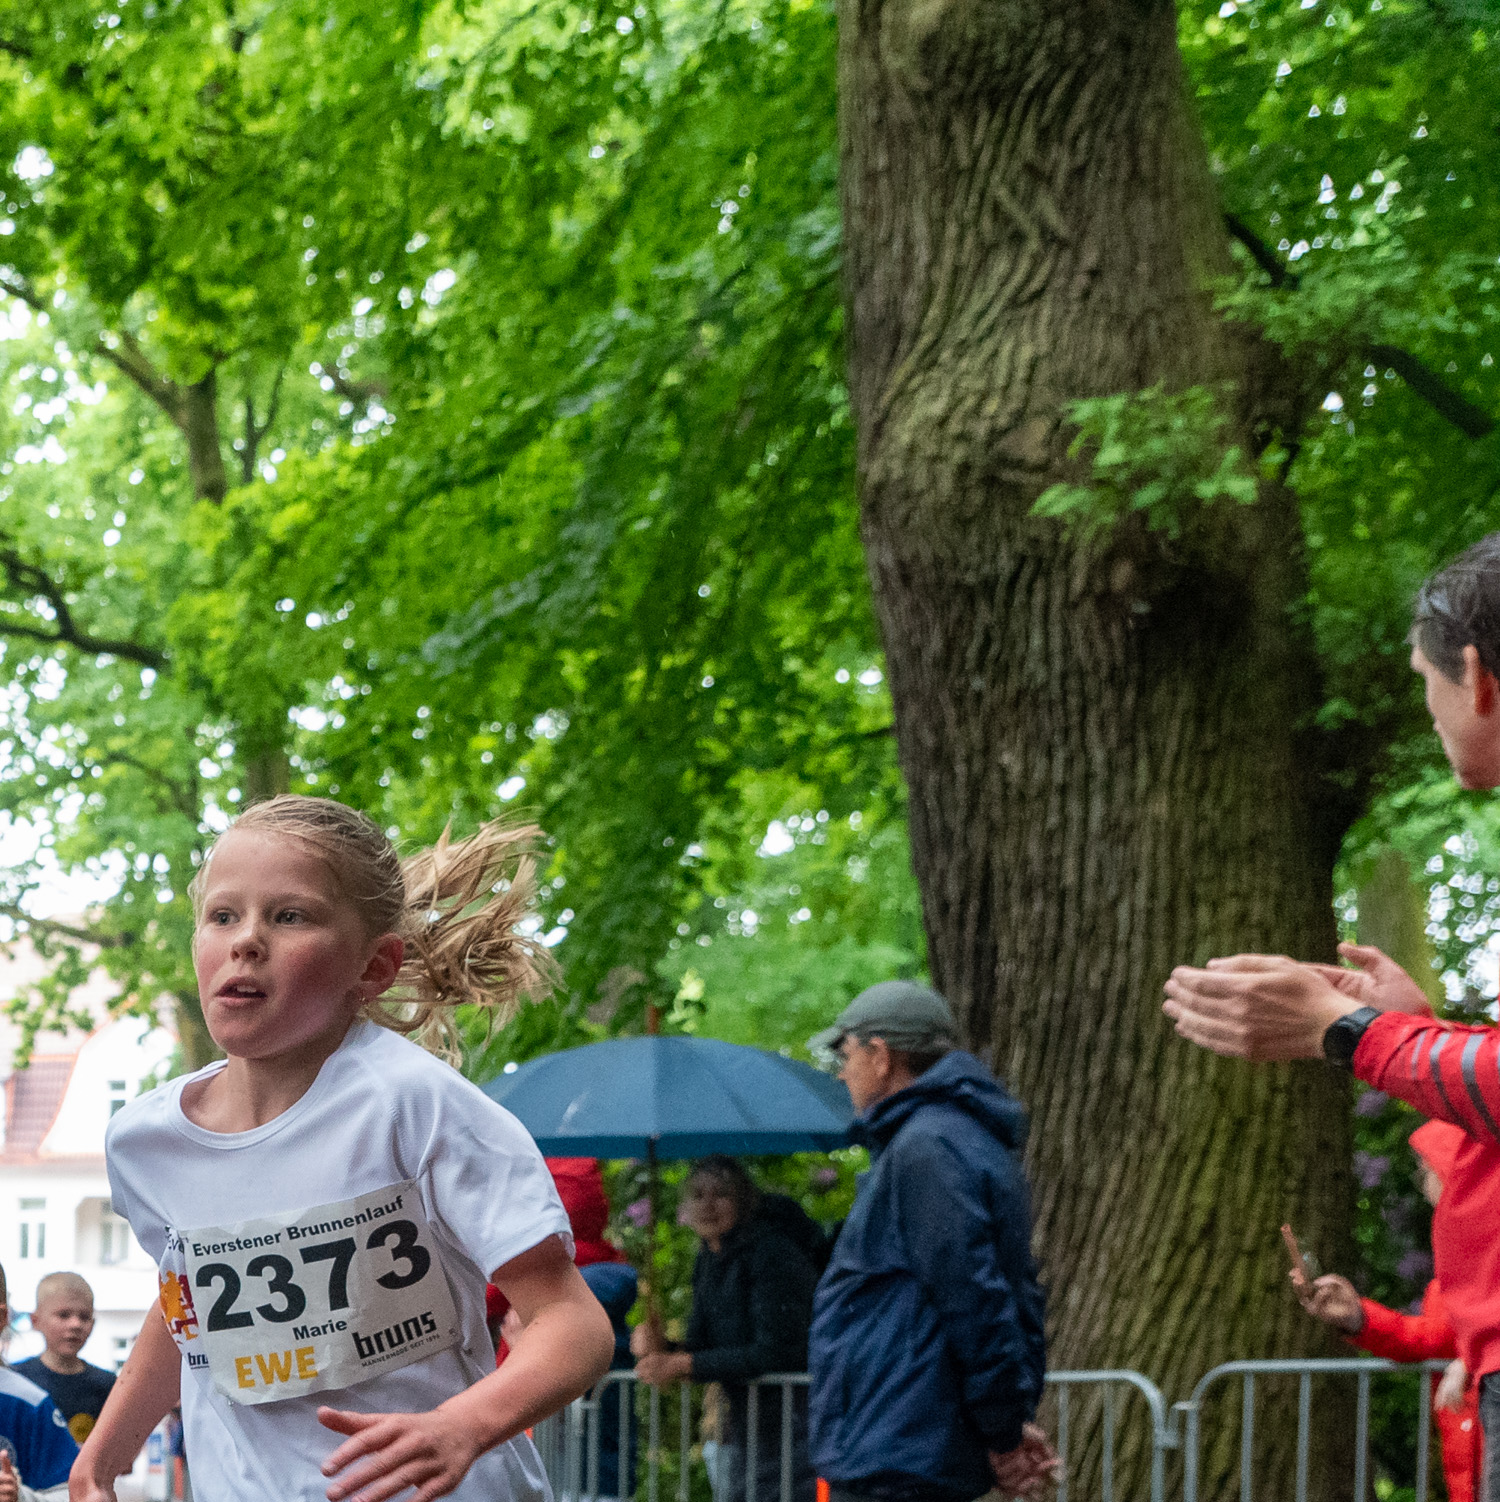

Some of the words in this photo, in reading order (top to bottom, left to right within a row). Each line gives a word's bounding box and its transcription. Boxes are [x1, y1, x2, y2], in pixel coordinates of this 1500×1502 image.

[192, 1232, 282, 1257] Everstener
[287, 1195, 404, 1241] Brunnenlauf
[195, 1219, 431, 1333] 2373
[187, 1352, 209, 1366] bru
[234, 1346, 319, 1389] EWE
[352, 1311, 437, 1359] bruns
[293, 1319, 348, 1341] Marie
